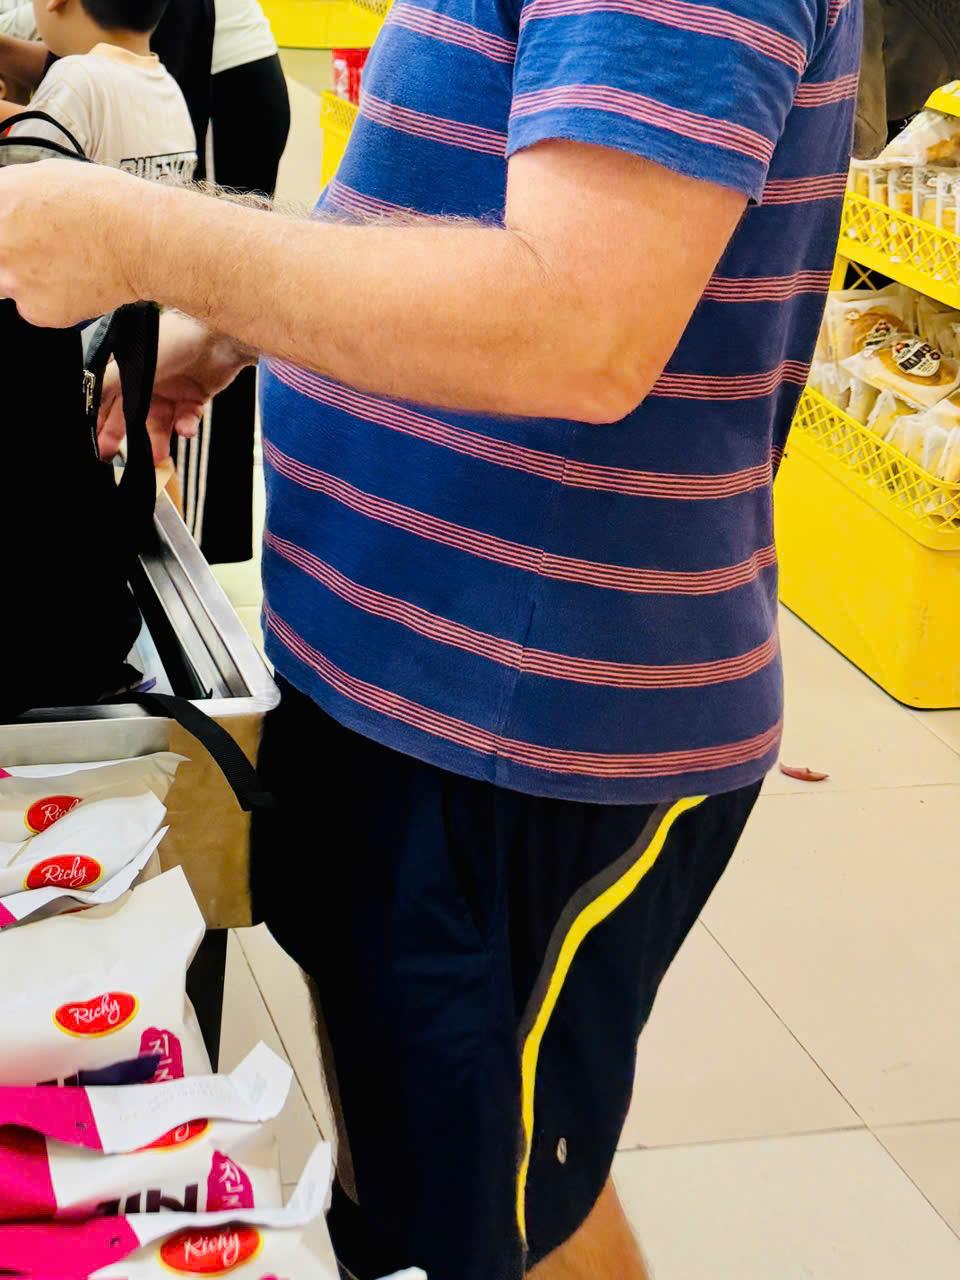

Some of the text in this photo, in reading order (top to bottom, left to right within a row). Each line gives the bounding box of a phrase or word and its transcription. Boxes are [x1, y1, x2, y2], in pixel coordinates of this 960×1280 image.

[41, 856, 86, 887] Richy
[68, 992, 121, 1025] Richy
[184, 1232, 240, 1267] Richy
